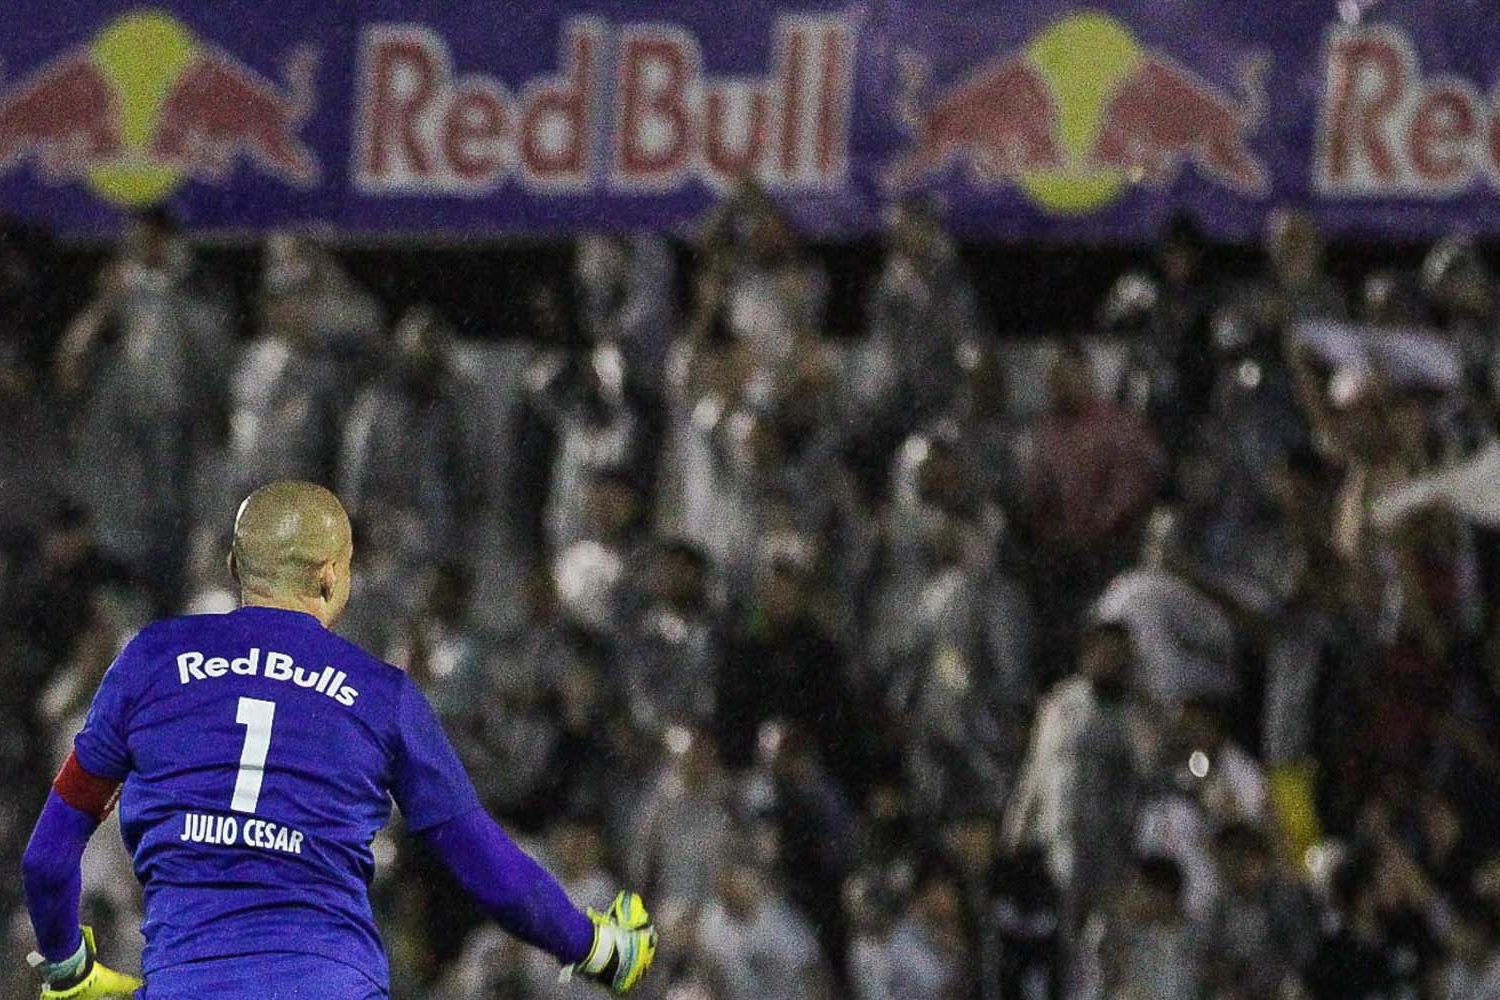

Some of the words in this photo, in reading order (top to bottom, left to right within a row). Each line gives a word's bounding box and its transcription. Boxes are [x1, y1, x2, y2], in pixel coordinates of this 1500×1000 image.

[353, 16, 604, 192] Red
[612, 14, 855, 194] Bull
[1314, 22, 1500, 196] Re
[176, 648, 260, 684] Red
[264, 651, 359, 706] Bulls
[230, 697, 276, 813] 1
[180, 813, 238, 845] JULIO
[243, 818, 304, 853] CESAR
